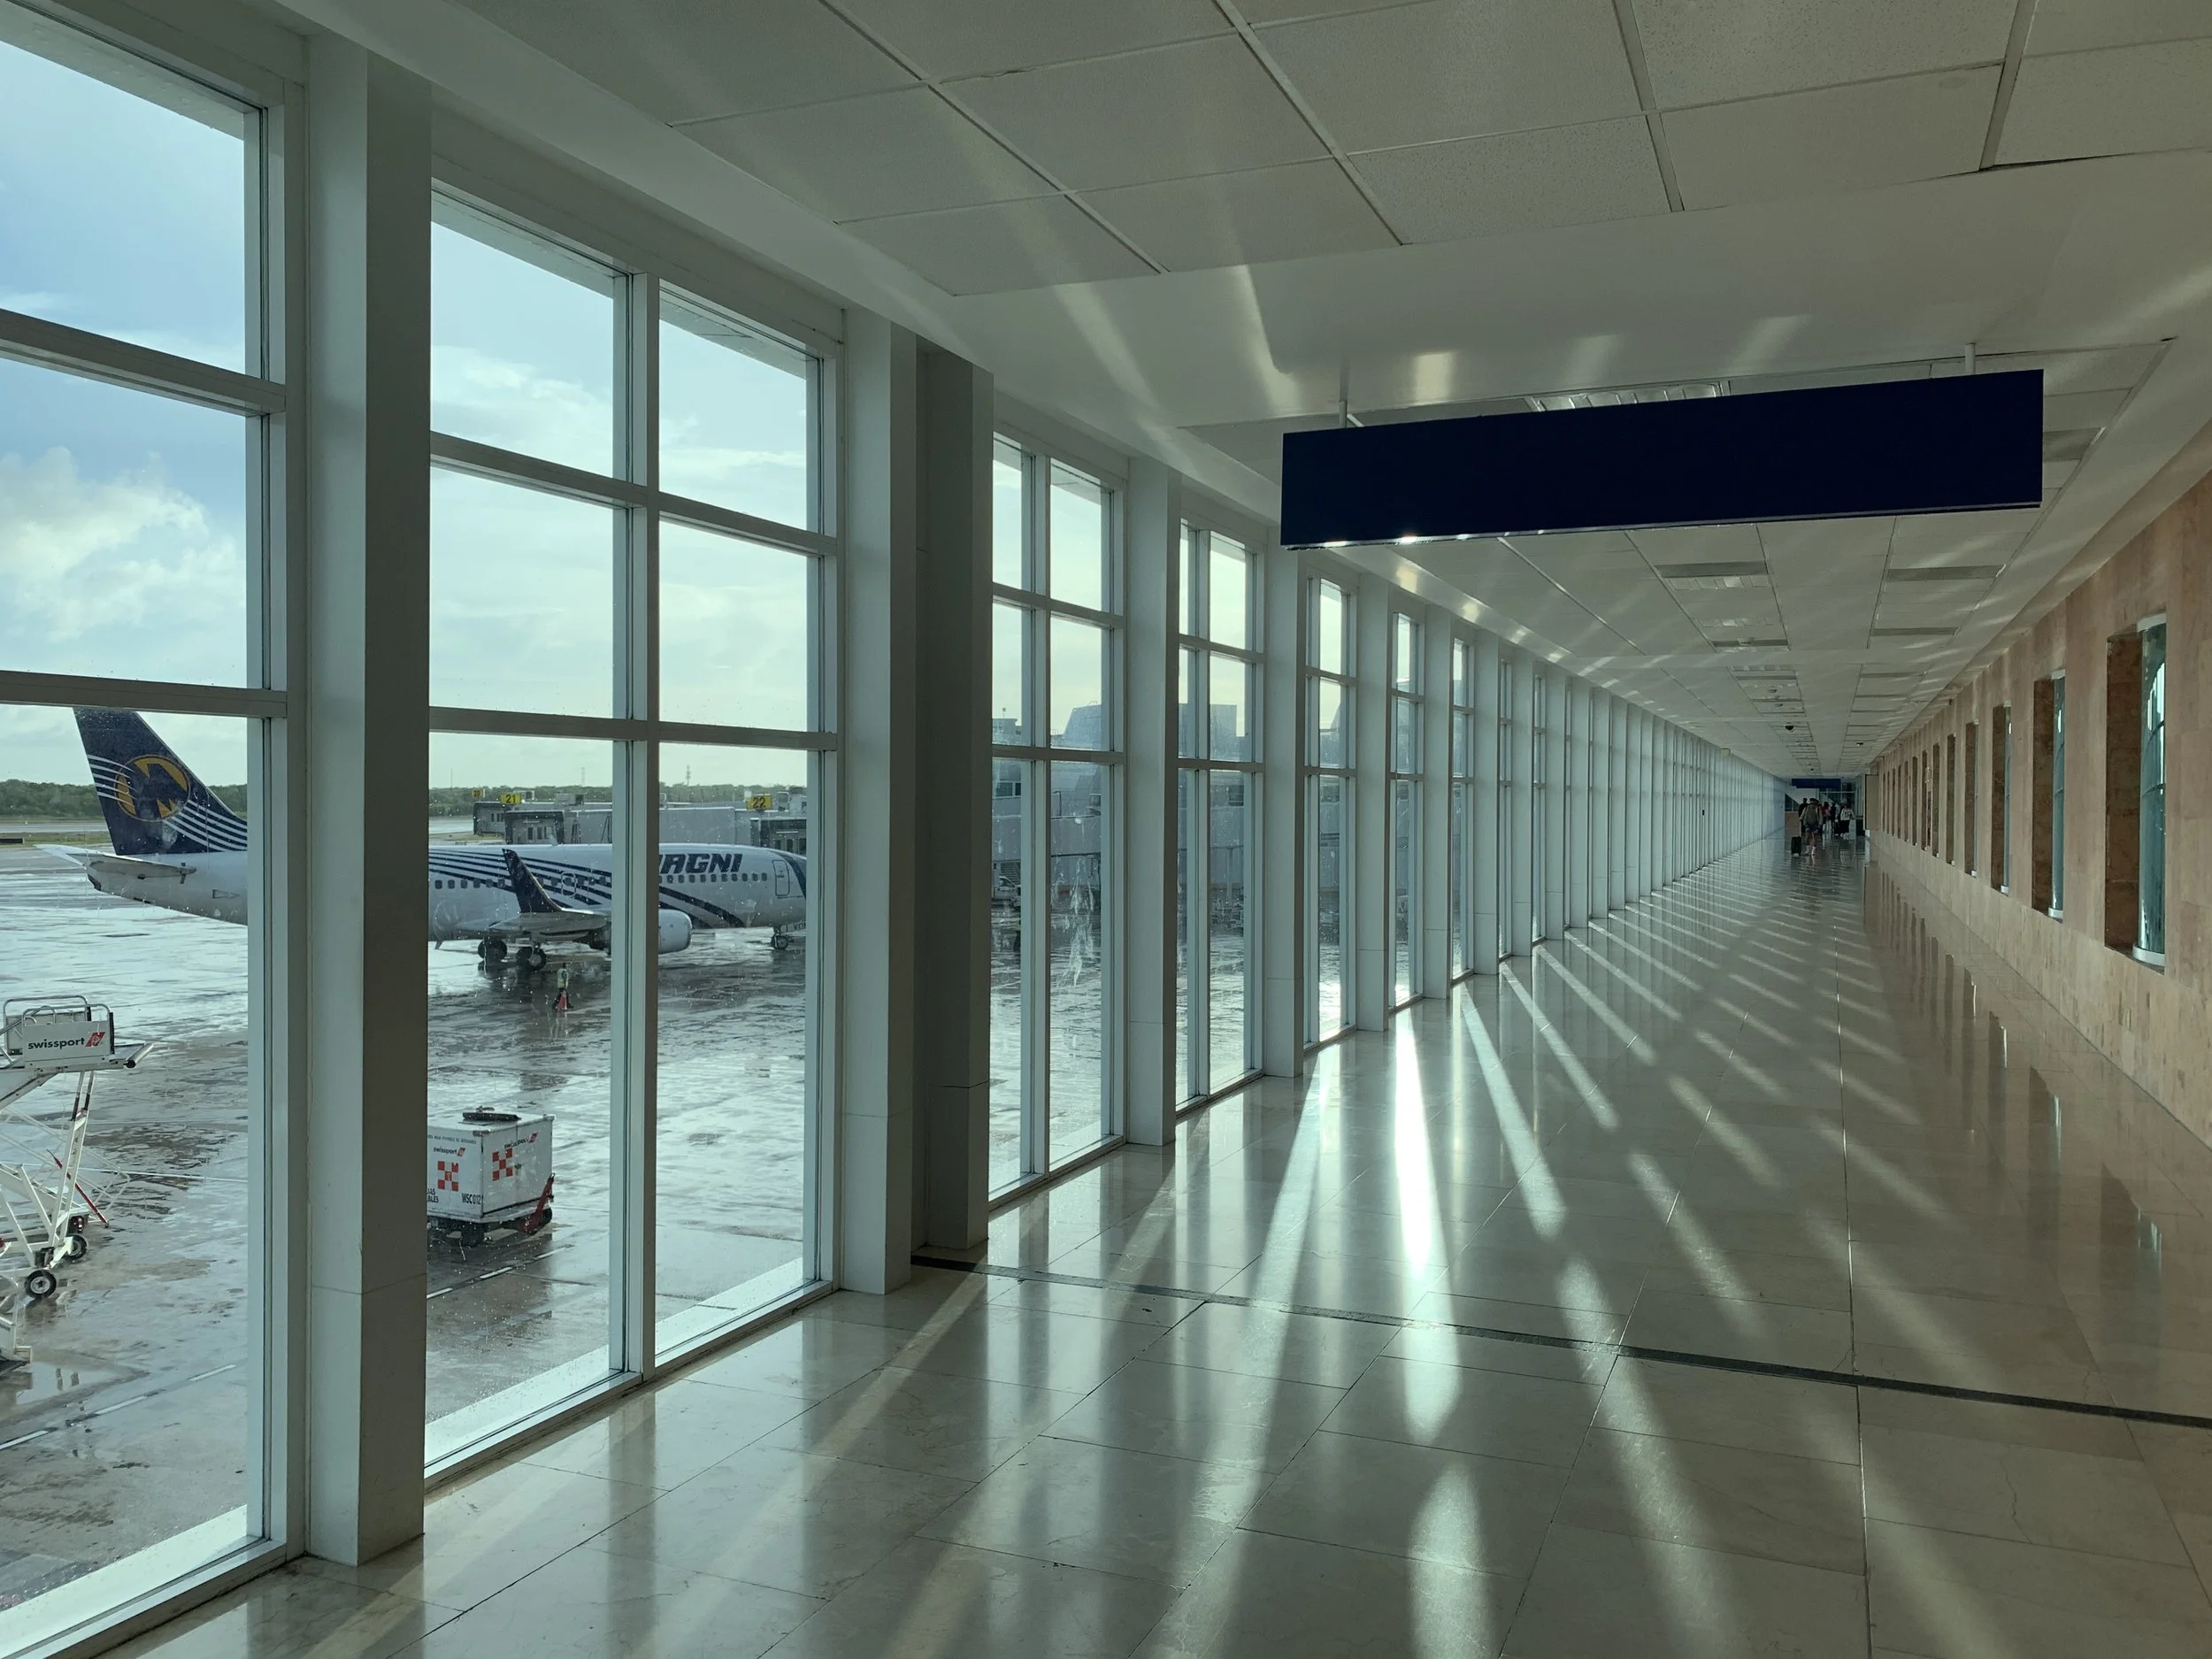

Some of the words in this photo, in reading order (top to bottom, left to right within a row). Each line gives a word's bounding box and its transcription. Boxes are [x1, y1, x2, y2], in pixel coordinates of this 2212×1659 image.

[505, 794, 517, 804] 21
[752, 795, 766, 809] 22
[658, 853, 743, 874] AGNI
[27, 1037, 86, 1050] swissport
[433, 1145, 457, 1156] swissport
